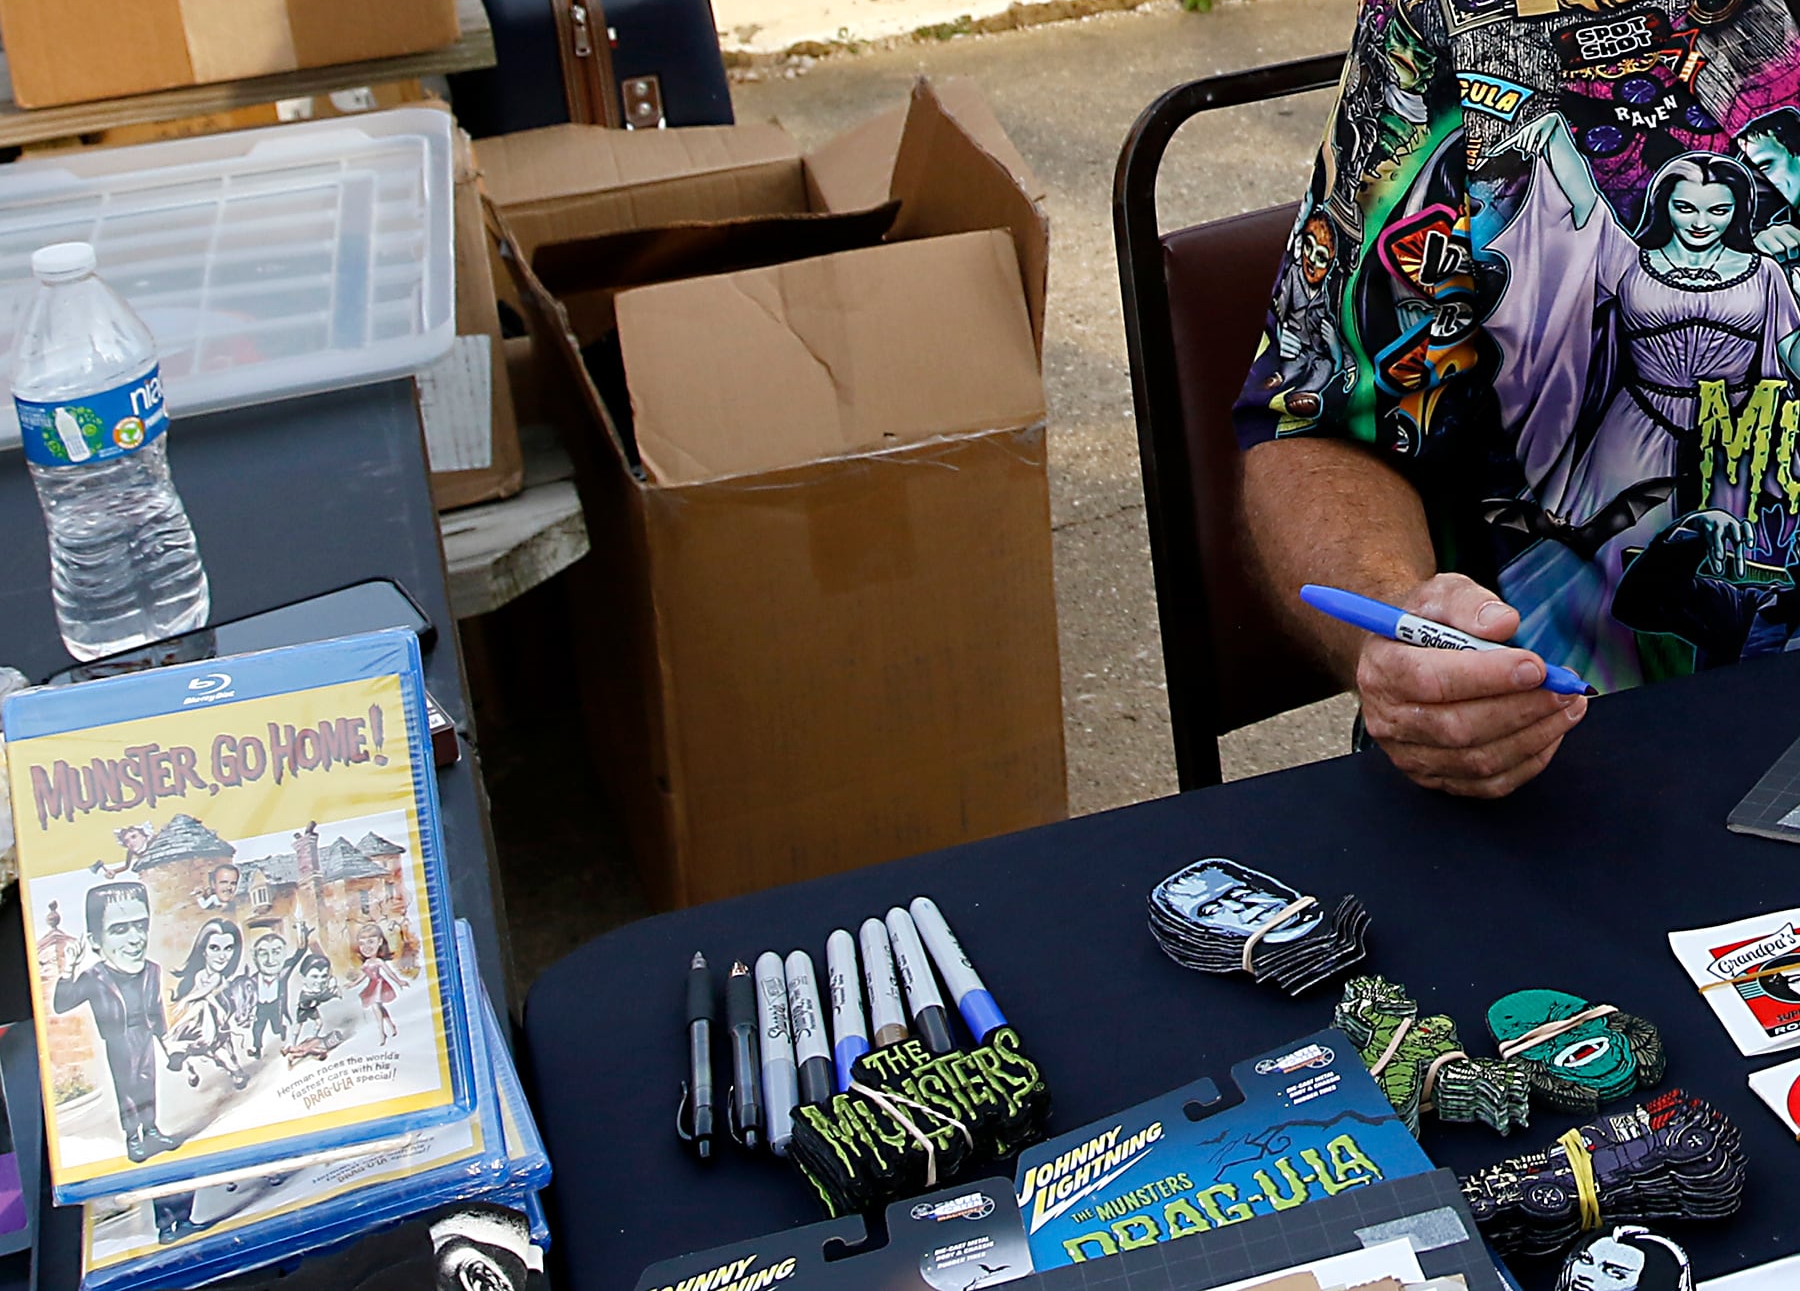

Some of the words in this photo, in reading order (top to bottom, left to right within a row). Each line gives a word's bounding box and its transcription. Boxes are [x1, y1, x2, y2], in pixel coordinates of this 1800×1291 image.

[1576, 16, 1647, 44] SPOT
[1581, 31, 1652, 60] SHOT
[1614, 93, 1678, 129] RAVEN
[210, 734, 267, 788] GO
[267, 702, 389, 785] HOME!
[1718, 929, 1797, 978] Grandpa's
[277, 1073, 314, 1099] Herman
[316, 1059, 346, 1077] races
[346, 1056, 363, 1067] the
[355, 1067, 398, 1084] special!
[862, 1040, 931, 1080] THE
[291, 1077, 325, 1100] fastest
[327, 1070, 349, 1083] cars
[352, 1064, 373, 1075] with
[375, 1061, 391, 1071] his
[1017, 1125, 1122, 1207] JOHNNY
[1030, 1121, 1164, 1235] LIGHTNING
[1072, 1209, 1095, 1224] THE
[1095, 1172, 1194, 1222] MUNSTERS
[648, 1254, 758, 1291] HNNY
